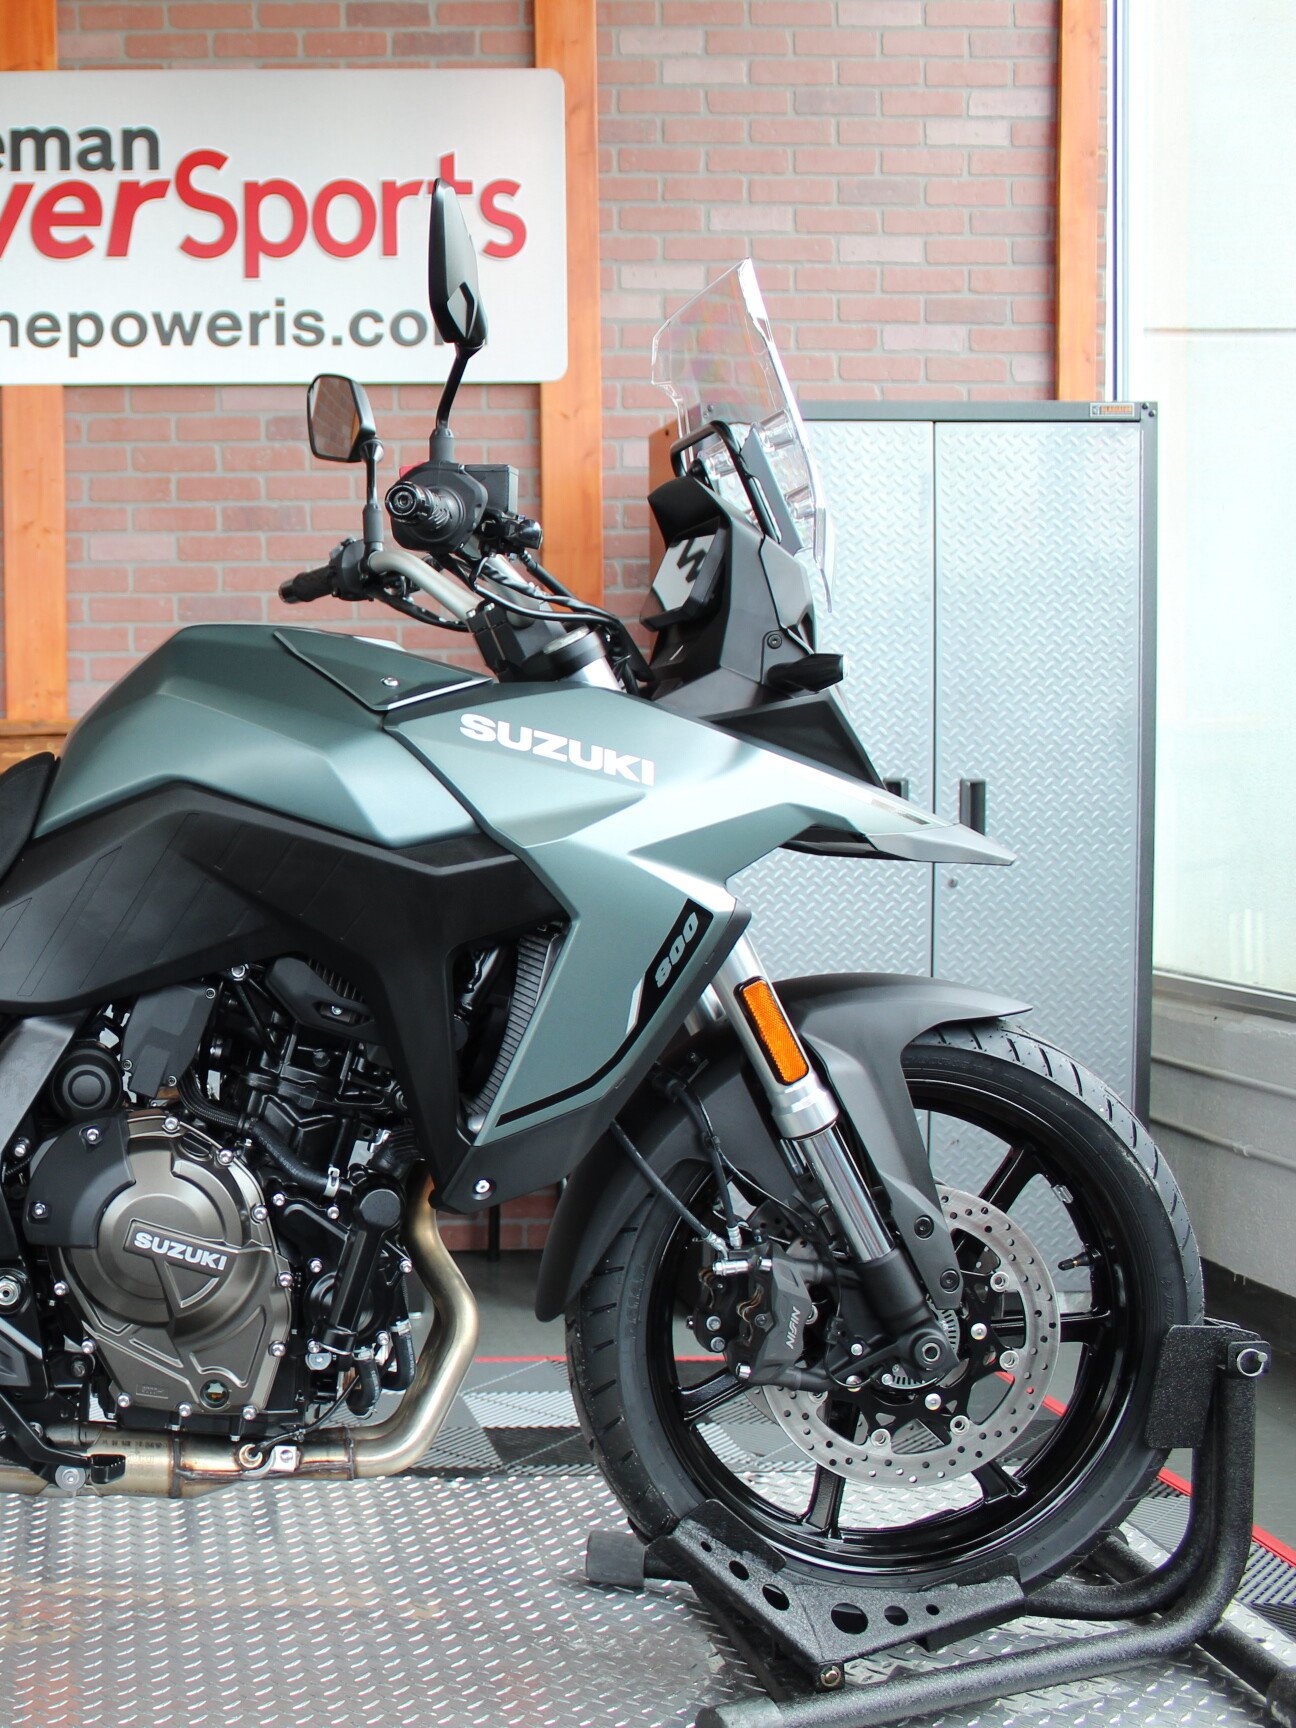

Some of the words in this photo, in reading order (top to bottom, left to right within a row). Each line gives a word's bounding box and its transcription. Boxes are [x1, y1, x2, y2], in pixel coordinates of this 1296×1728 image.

[460, 713, 655, 786] SUZUKI
[655, 912, 699, 988] 800
[135, 1232, 227, 1270] SUZUKI
